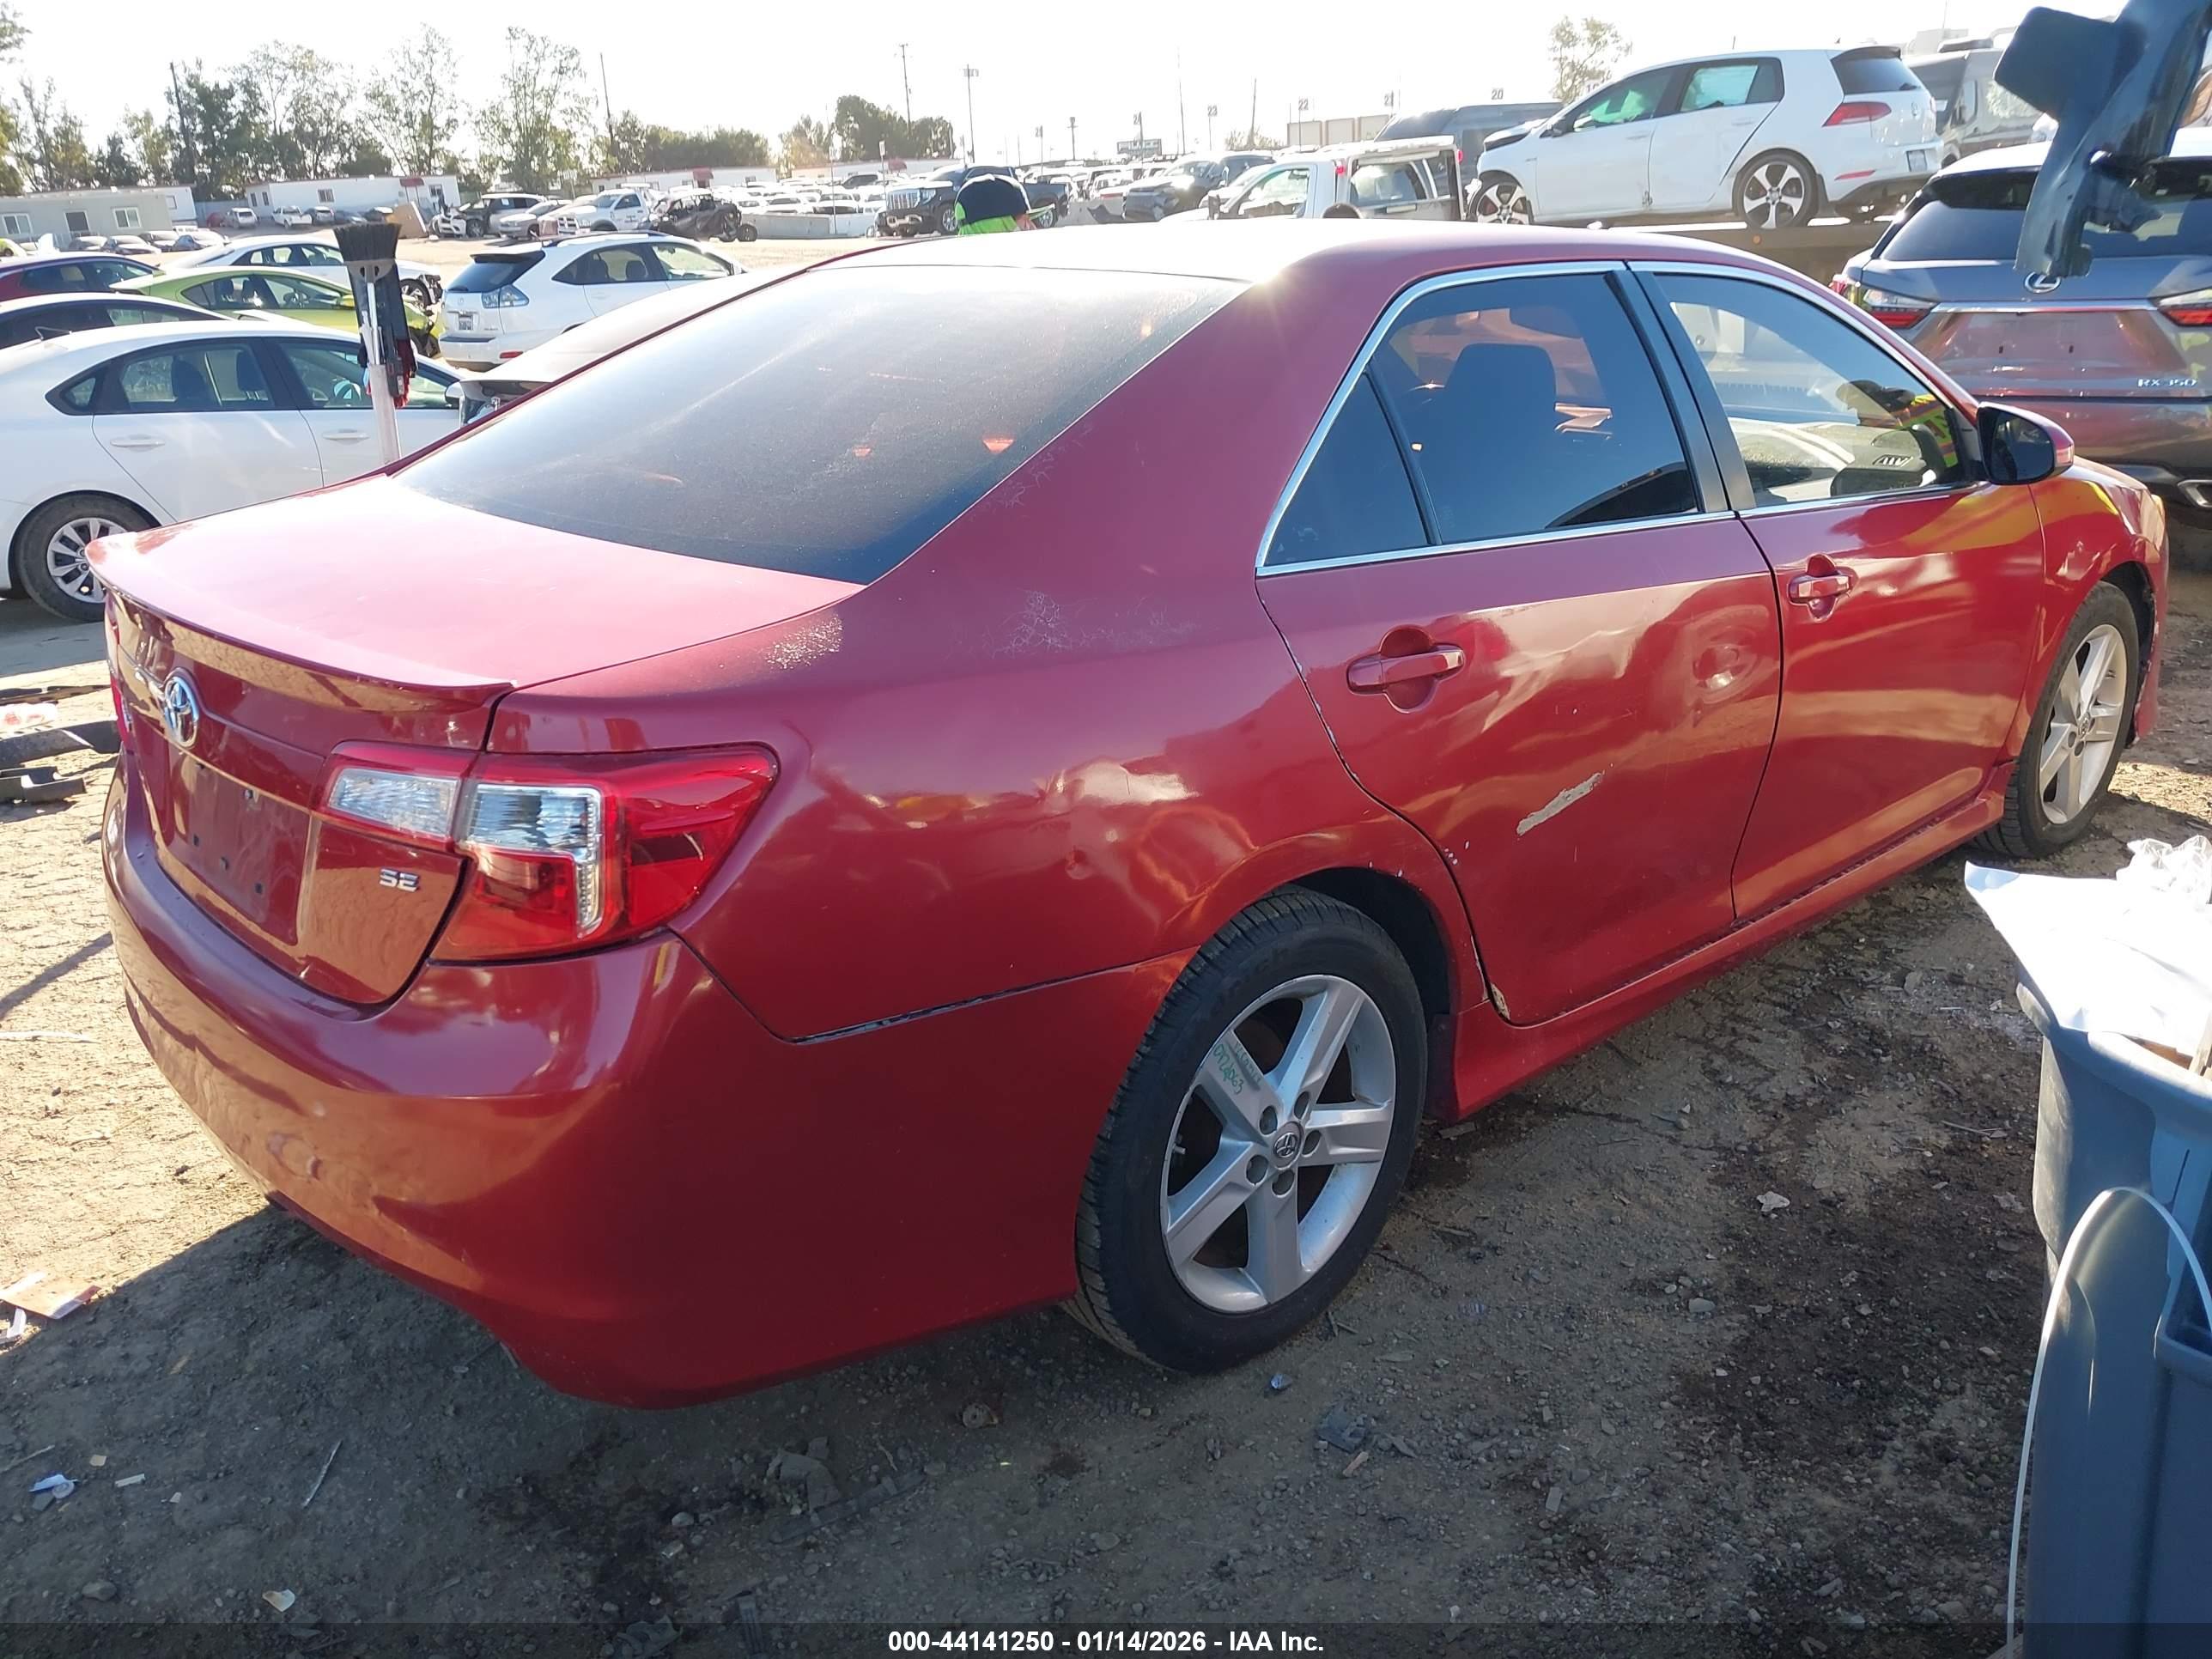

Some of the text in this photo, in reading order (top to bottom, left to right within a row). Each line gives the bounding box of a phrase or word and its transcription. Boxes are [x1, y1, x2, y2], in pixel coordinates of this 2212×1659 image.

[1492, 88, 1504, 100] 20
[1298, 98, 1309, 111] 22
[1207, 105, 1218, 117] 23
[2137, 378, 2160, 387] RX
[379, 868, 420, 893] SE
